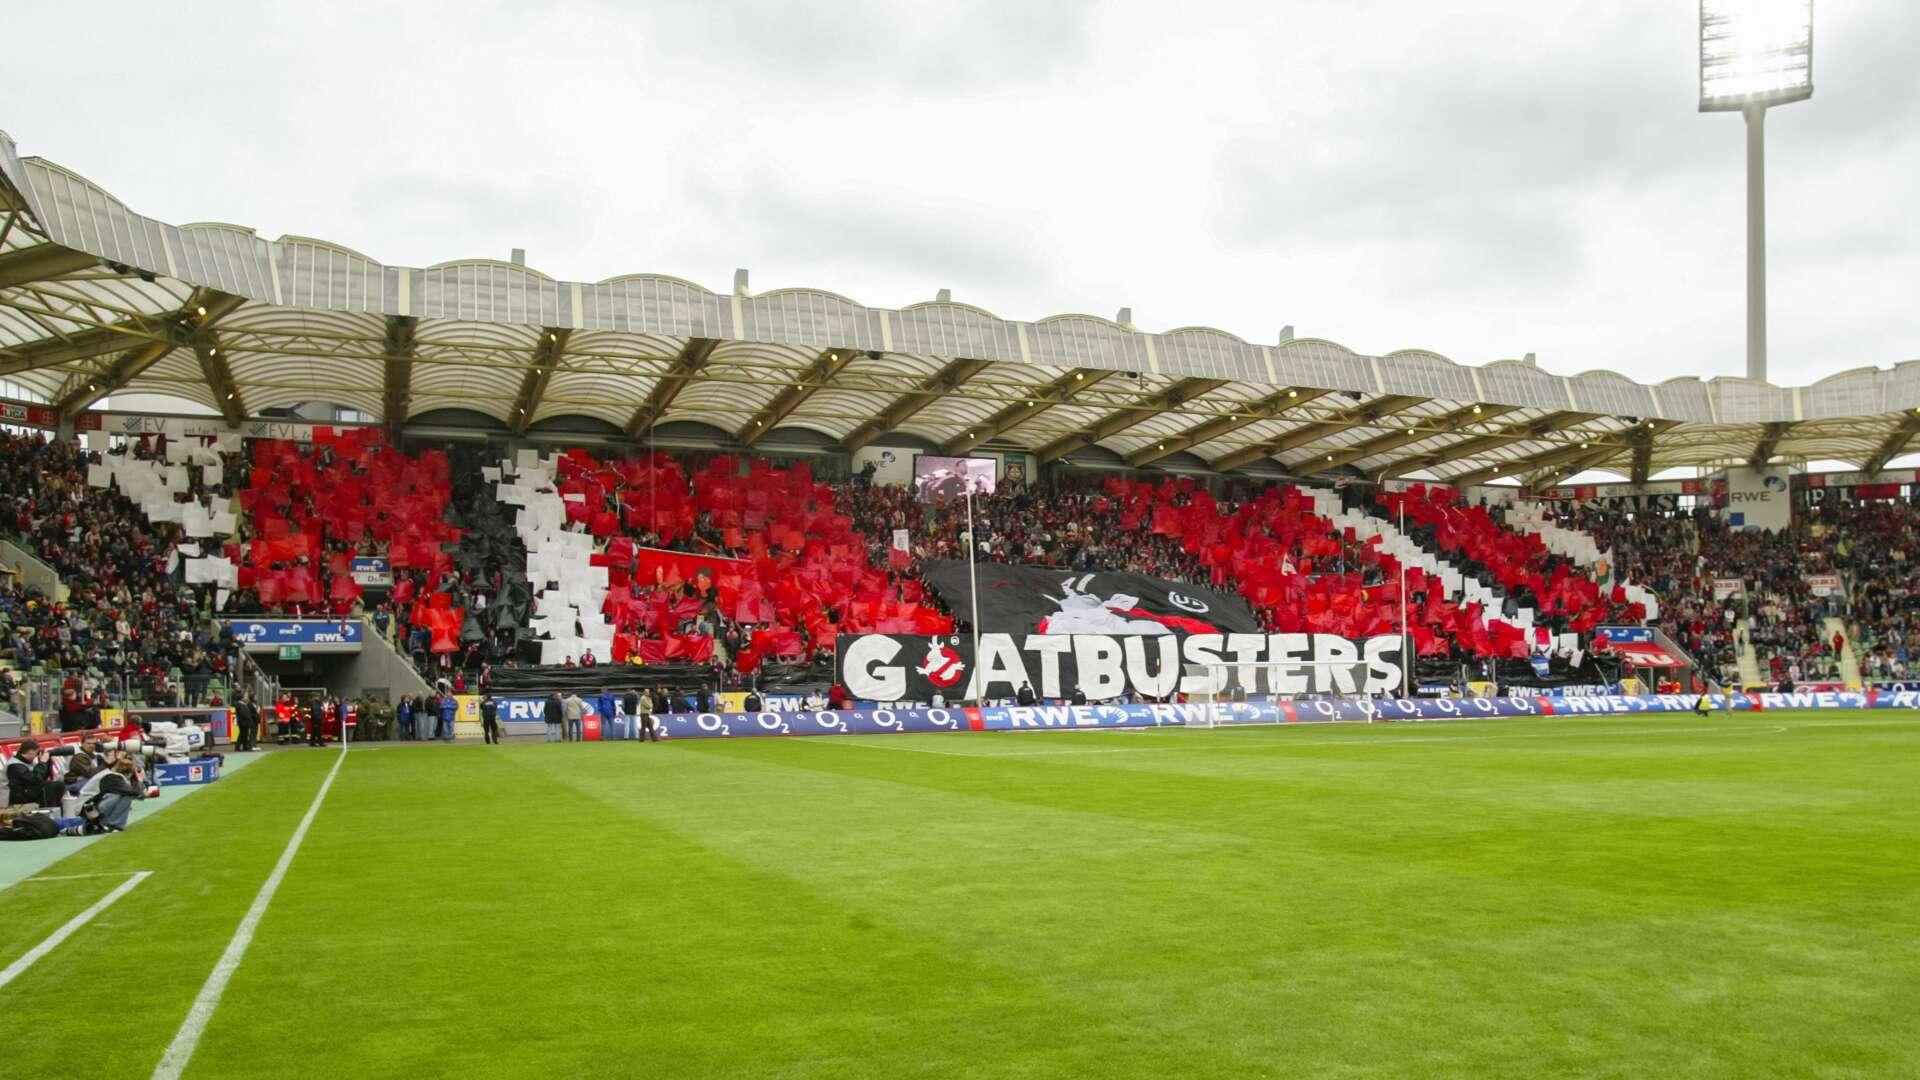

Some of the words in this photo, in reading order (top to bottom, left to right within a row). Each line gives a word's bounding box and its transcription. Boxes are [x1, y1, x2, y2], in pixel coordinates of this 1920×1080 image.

[1731, 491, 1771, 503] RWE
[236, 633, 257, 642] WE
[314, 633, 346, 642] RWE
[1563, 685, 1597, 697] RWE
[1567, 696, 1630, 712] RWE
[1760, 692, 1840, 708] RWE
[697, 713, 731, 735] O2
[757, 711, 790, 733] O2
[815, 710, 848, 732] O2
[872, 710, 904, 731] O2
[927, 709, 959, 729] O2
[1008, 706, 1099, 727] RWE
[1151, 703, 1234, 723] RWE
